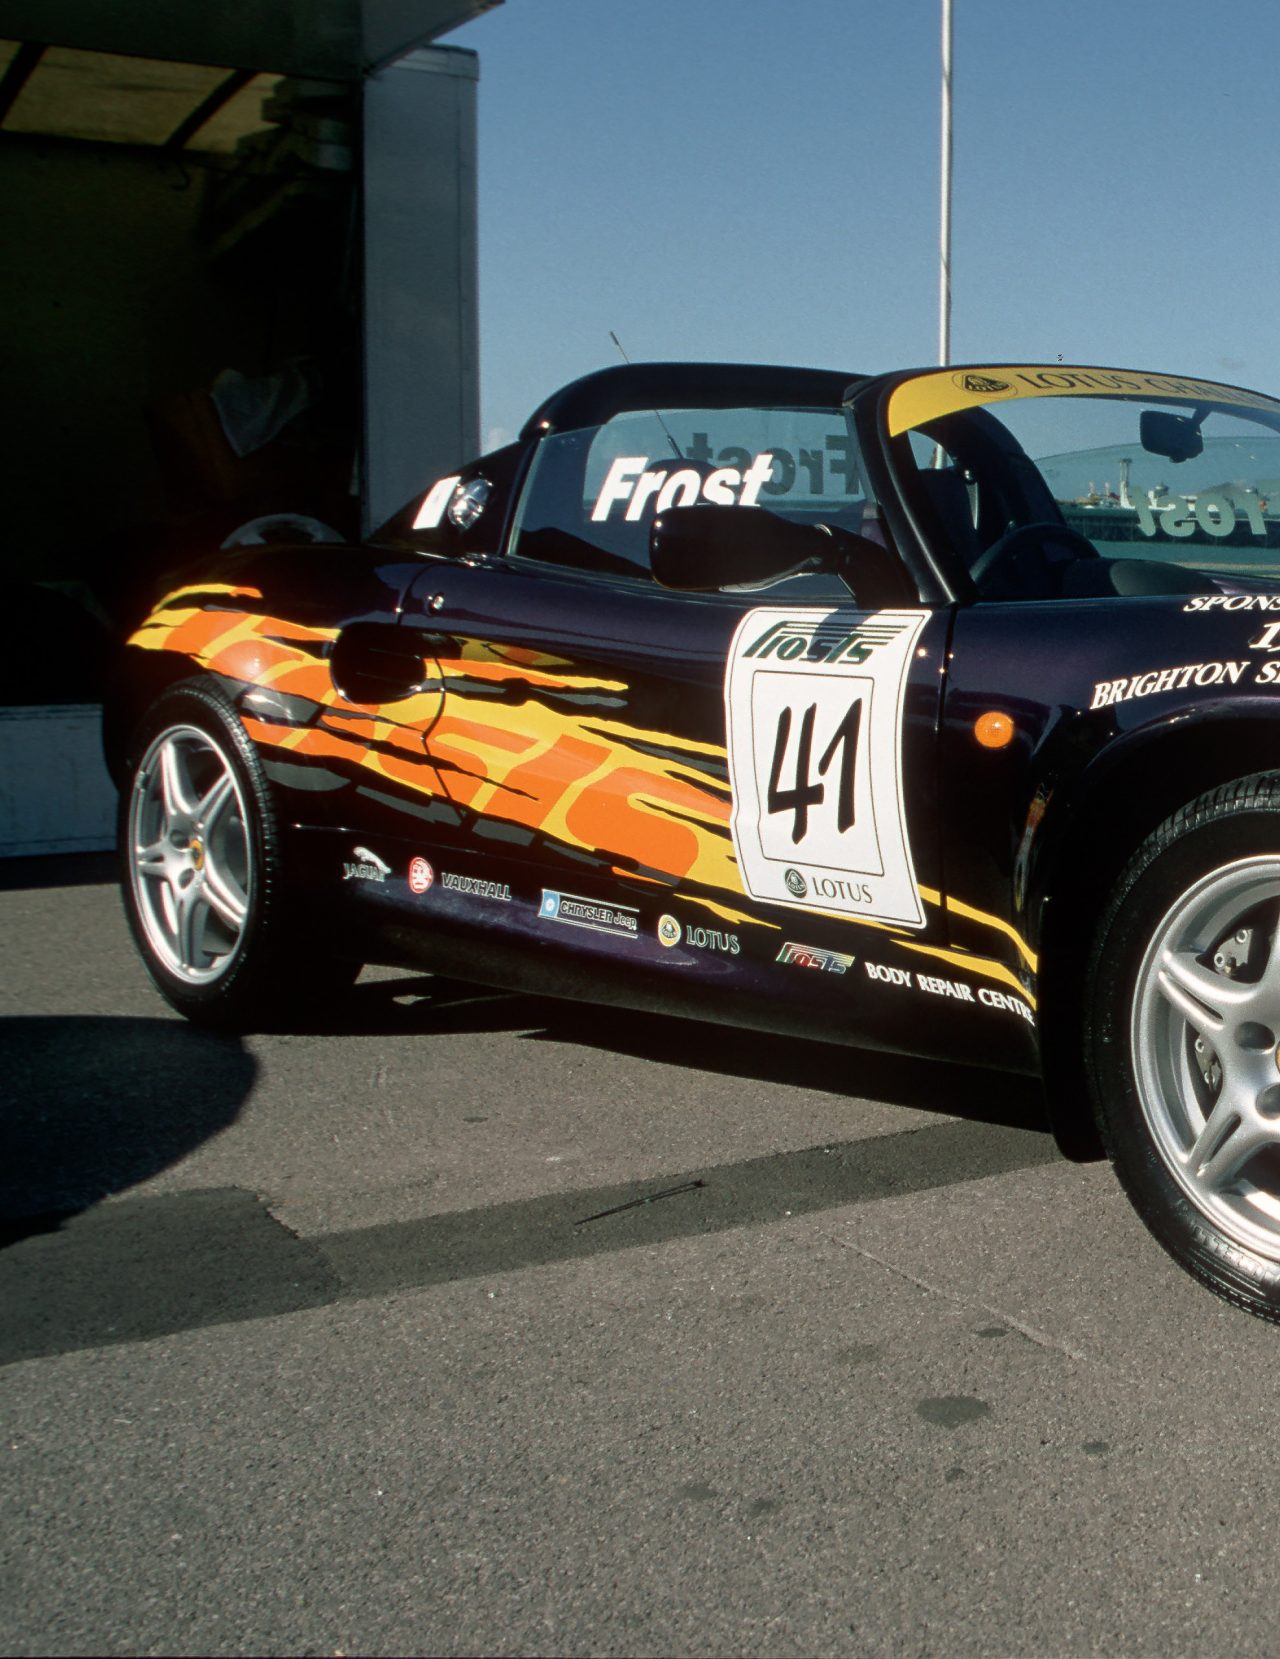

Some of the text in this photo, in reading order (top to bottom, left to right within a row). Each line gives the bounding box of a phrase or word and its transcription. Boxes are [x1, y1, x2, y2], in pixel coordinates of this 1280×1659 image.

[1017, 373, 1141, 390] LOTUS
[591, 453, 774, 523] Frost
[1089, 660, 1251, 711] BRIGHTON
[767, 697, 863, 846] 41
[441, 872, 512, 901] VAUXHALL
[812, 877, 873, 904] LOTUS
[560, 901, 638, 931] CHRYSLER Jeep
[686, 924, 741, 955] LOTUS
[864, 961, 913, 989] BODY
[917, 973, 975, 1003] REPAIR
